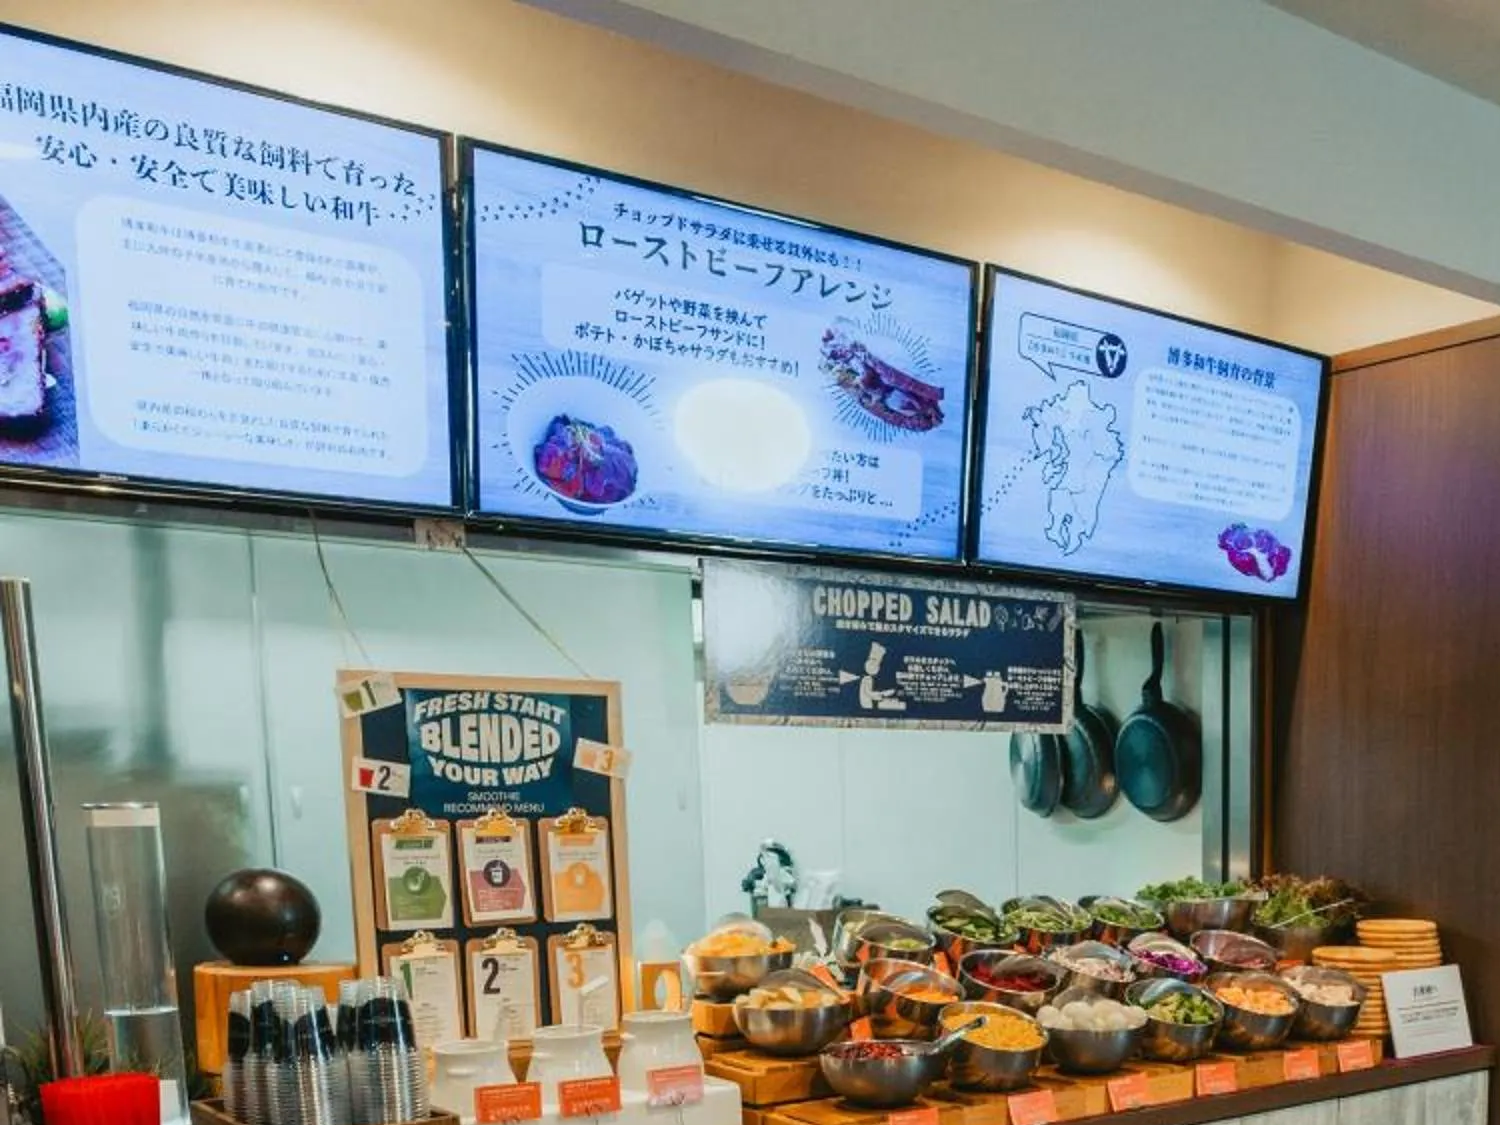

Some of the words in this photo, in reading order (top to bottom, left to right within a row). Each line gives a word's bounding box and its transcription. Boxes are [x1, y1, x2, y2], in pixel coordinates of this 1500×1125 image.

[36, 134, 379, 227] 安心・安全で美味しい和牛
[580, 221, 893, 311] ローストビーフアレンジ
[615, 288, 767, 330] バゲットや野菜を挟んで
[813, 585, 912, 622] CHOPPED
[926, 597, 991, 628] SALAD
[414, 690, 492, 723] FRESH
[493, 691, 567, 725] START
[420, 712, 561, 763] BLENDED
[378, 765, 391, 790] 2
[427, 755, 498, 787] YOUR
[502, 757, 556, 787] WAY
[467, 791, 520, 801] SMOOTHIE
[514, 803, 545, 813] MENU
[482, 957, 501, 995] 2
[564, 952, 585, 989] 3
